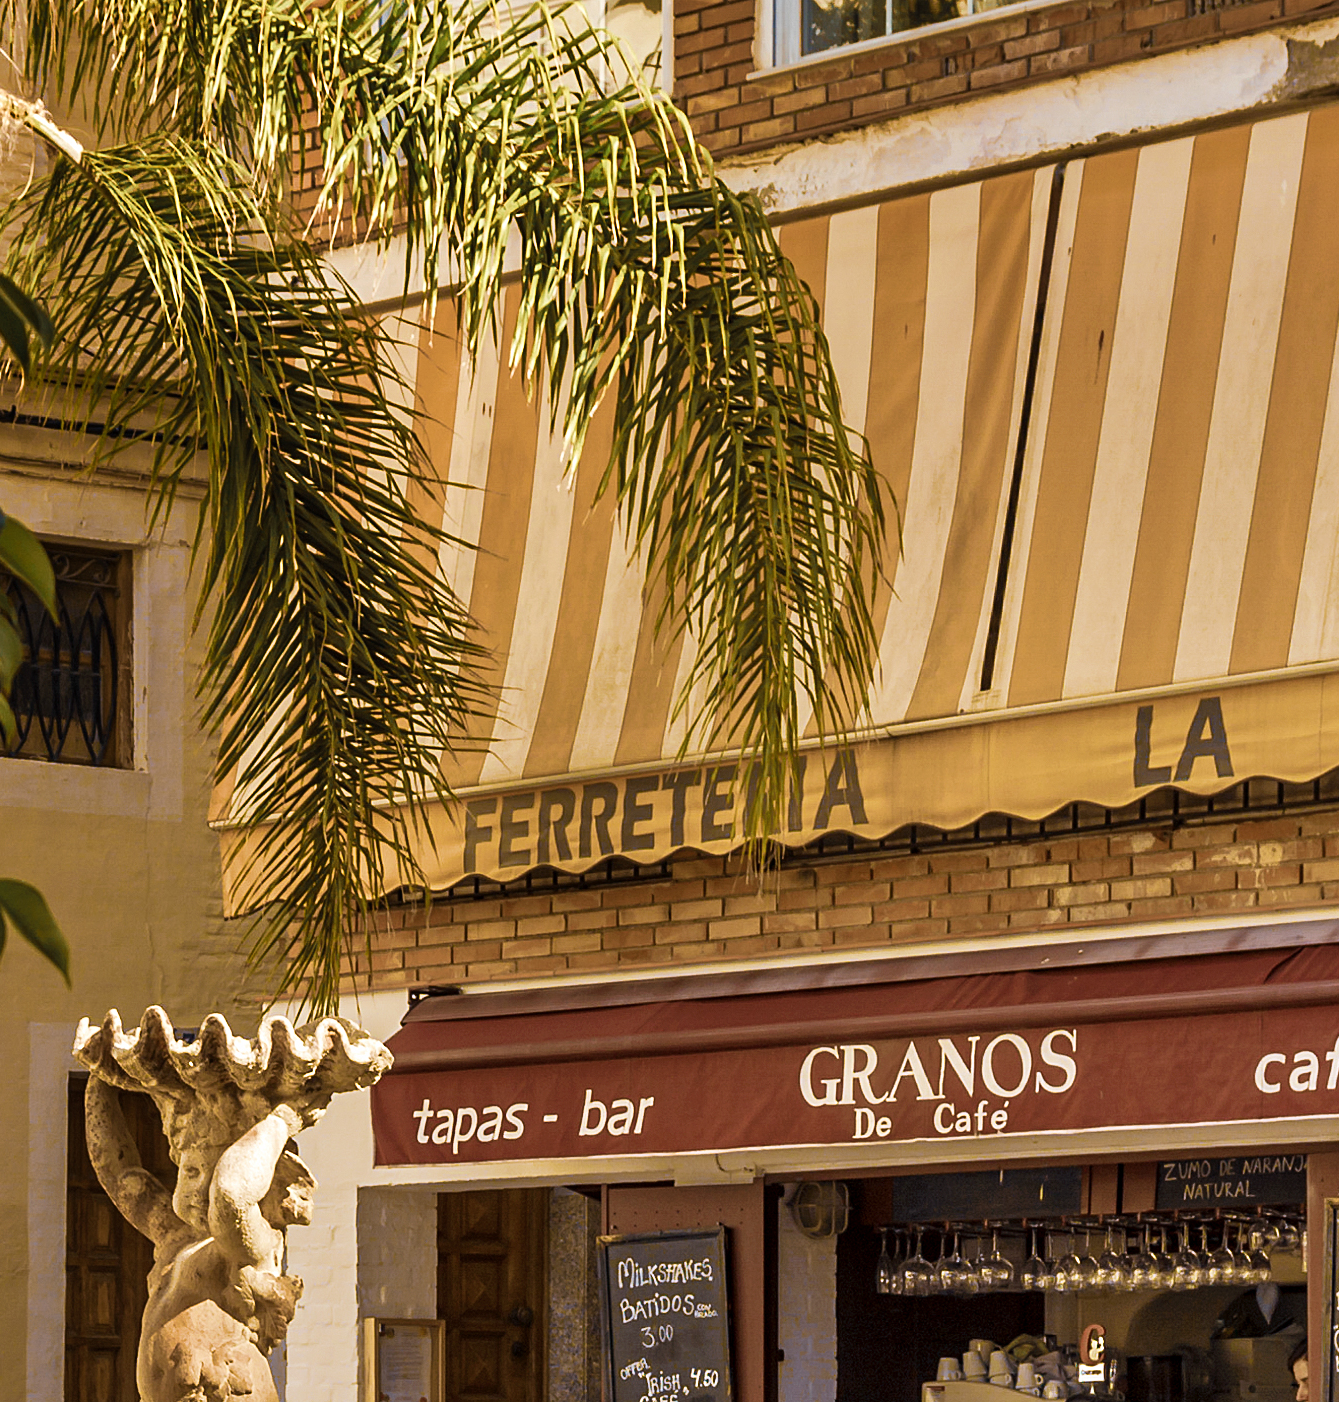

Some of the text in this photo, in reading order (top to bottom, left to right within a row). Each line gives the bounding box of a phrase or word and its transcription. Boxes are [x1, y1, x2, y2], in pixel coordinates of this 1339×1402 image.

[1133, 696, 1234, 787] LA
[799, 1029, 1078, 1107] GRANOS
[412, 1098, 528, 1154] tapas
[578, 1089, 655, 1136] bar
[852, 1100, 1010, 1138] De Café
[1163, 1159, 1210, 1182] ZUMO
[1219, 1158, 1236, 1176] DE
[1183, 1180, 1256, 1201] NATURAL
[641, 1325, 674, 1348] 3.00
[690, 1368, 719, 1388] 4.50
